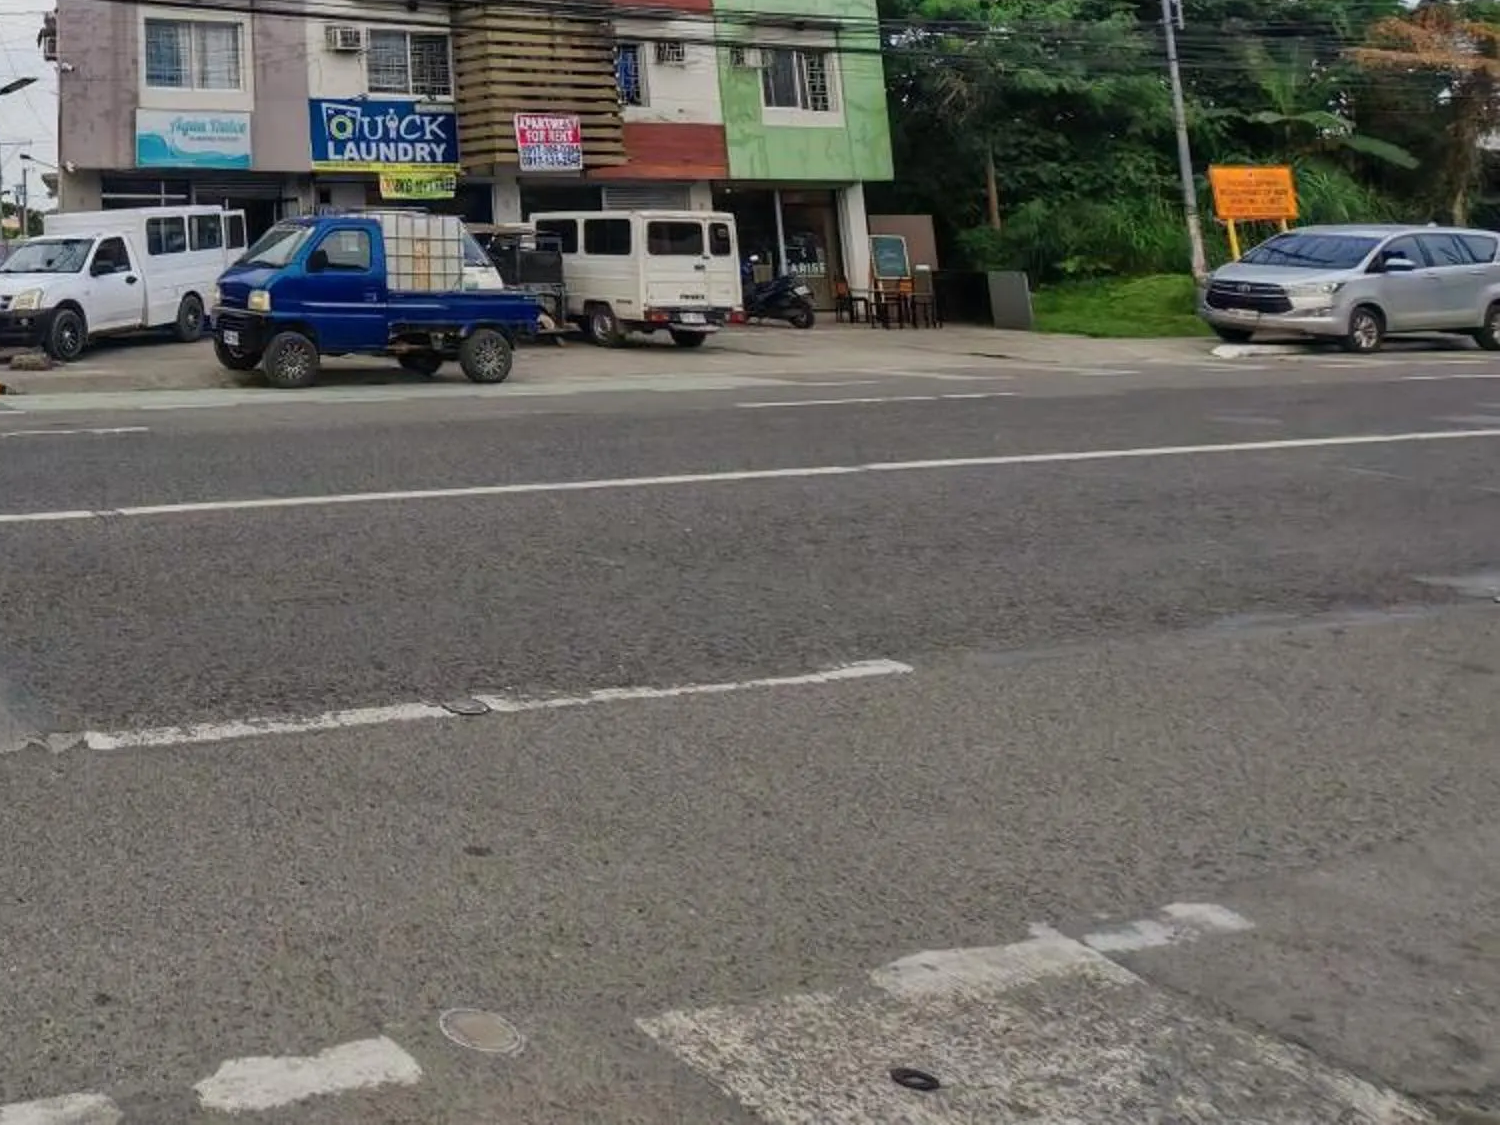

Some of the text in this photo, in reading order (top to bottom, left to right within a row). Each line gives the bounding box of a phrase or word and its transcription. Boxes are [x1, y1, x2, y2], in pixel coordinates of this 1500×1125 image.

[328, 109, 446, 140] QUICK
[526, 130, 573, 143] FOR RENT
[327, 140, 447, 162] LAUNDRY
